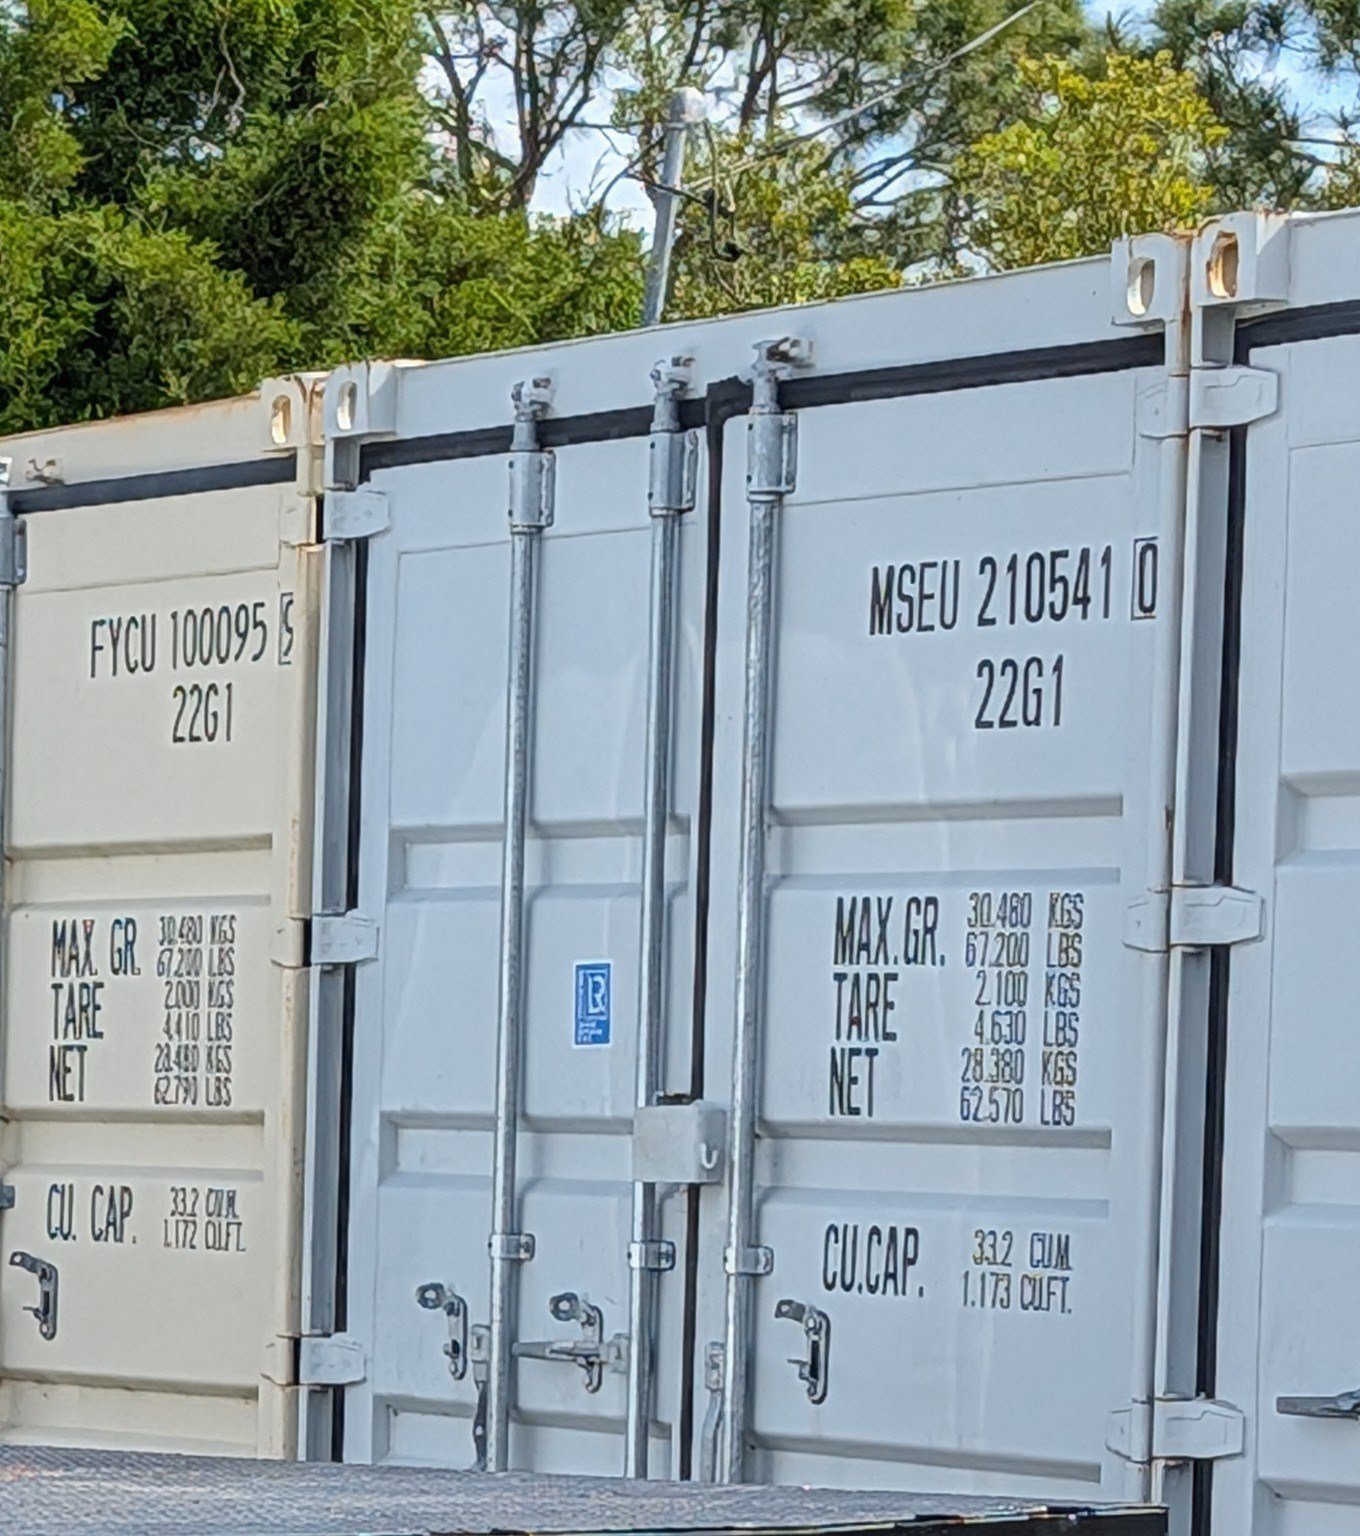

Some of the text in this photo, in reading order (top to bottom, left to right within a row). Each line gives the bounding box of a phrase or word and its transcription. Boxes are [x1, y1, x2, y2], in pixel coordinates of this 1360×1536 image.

[869, 539, 1159, 635] MSEU 210541 0
[90, 613, 157, 679] FYCU
[170, 601, 268, 671] 100095
[974, 653, 1064, 729] 22G1
[172, 681, 233, 744] 22G1
[209, 915, 237, 945] KGS
[1048, 892, 1085, 929] KGS
[51, 917, 141, 978] MAX. GR.
[208, 947, 235, 977] LBS
[965, 932, 1083, 969] 67.200 LBS
[208, 979, 234, 1009] KGS
[833, 972, 899, 1043] TARE
[974, 970, 1082, 1008] 2.100 KGS
[51, 981, 104, 1040] TARE
[207, 1011, 233, 1042] LBS
[973, 1009, 1080, 1048] 4.630 LBS
[49, 1045, 88, 1102] NET
[205, 1044, 233, 1075] KGS
[961, 1046, 1078, 1087] 28.380 KGS
[205, 1076, 232, 1107] LBS
[829, 1046, 879, 1118] NET
[960, 1086, 1076, 1127] 62.570 LBS
[47, 1183, 137, 1244] CU. CAP.
[962, 1270, 1011, 1310] 1.173
